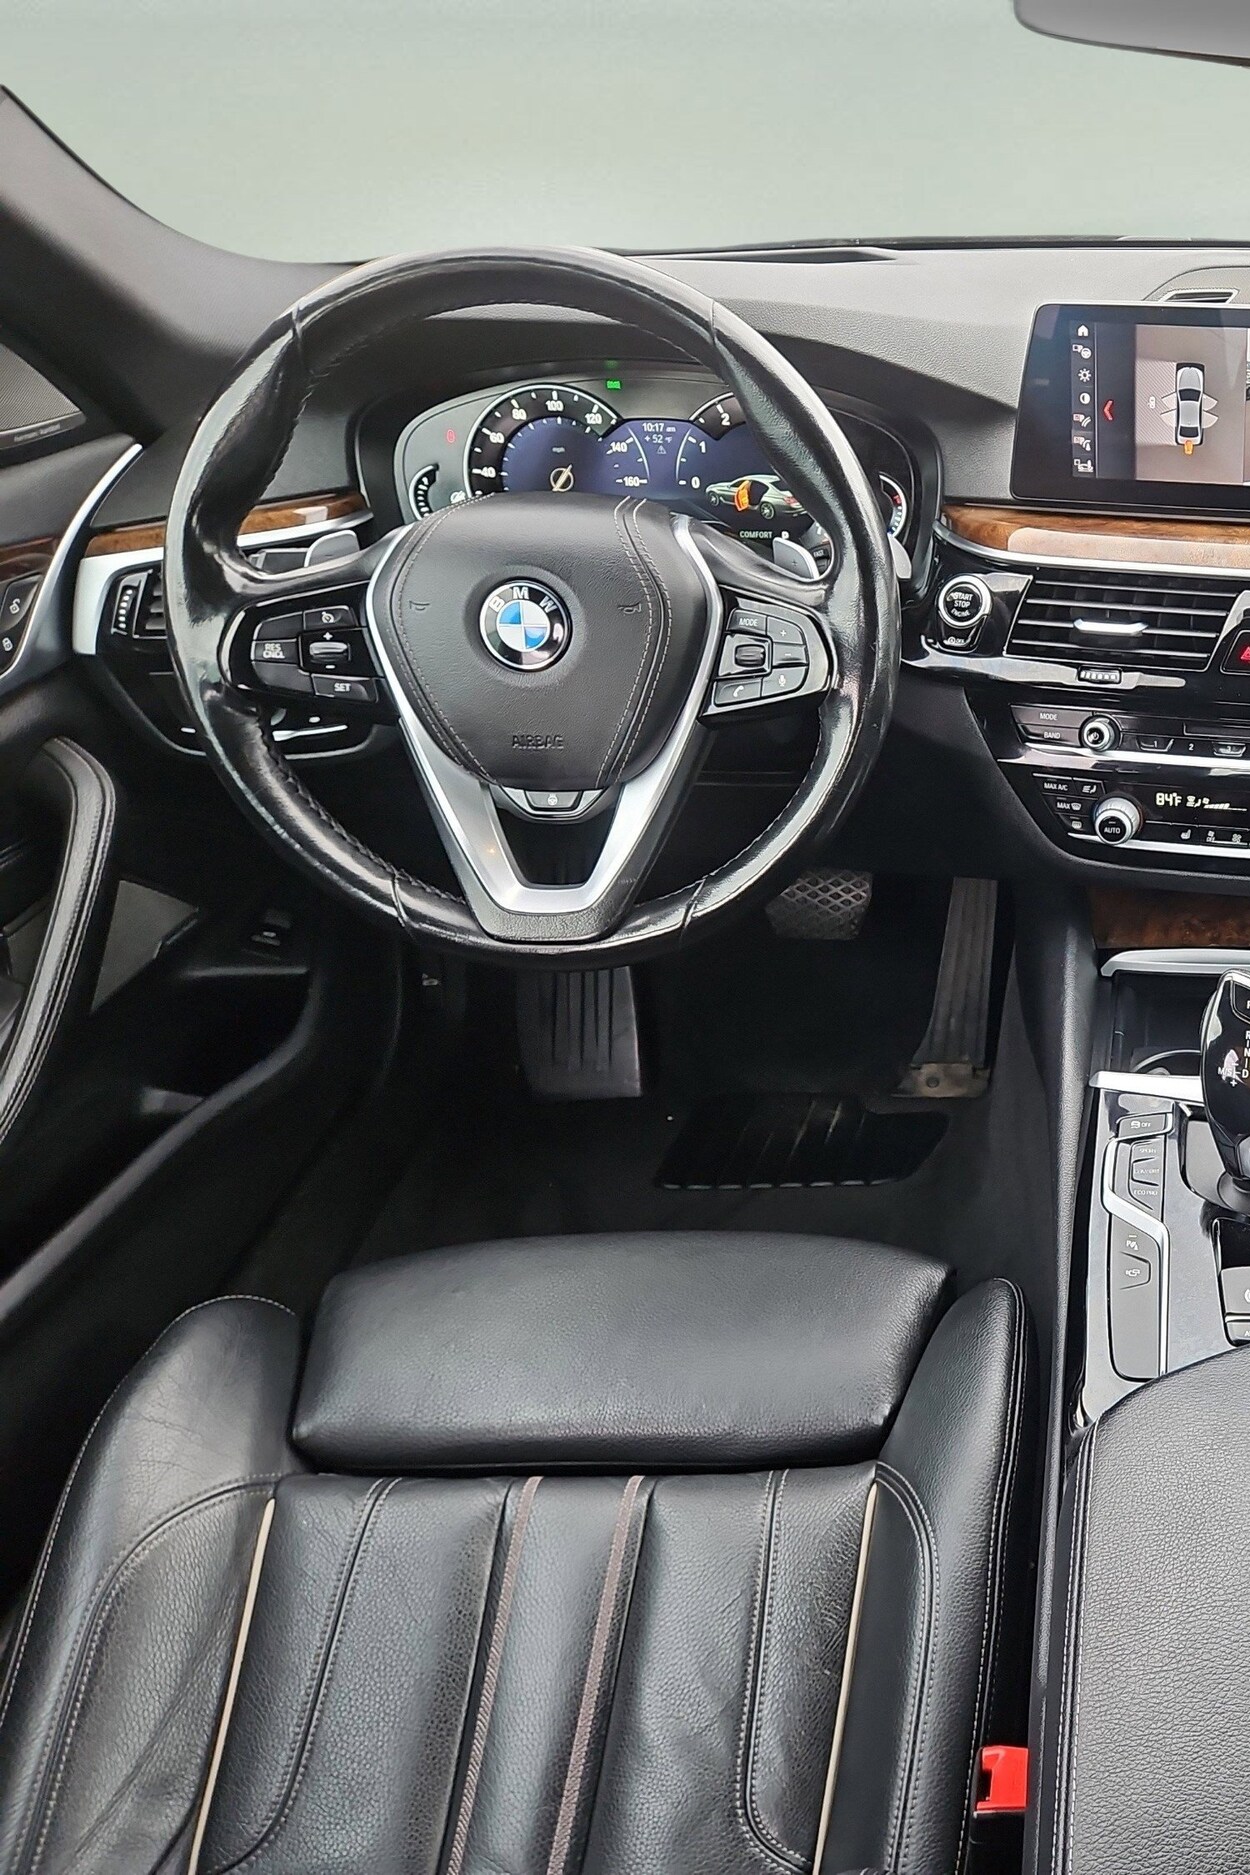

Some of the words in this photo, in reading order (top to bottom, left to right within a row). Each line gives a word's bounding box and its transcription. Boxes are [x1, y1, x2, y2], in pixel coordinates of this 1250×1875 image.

[545, 400, 564, 412] 100
[511, 408, 527, 421] 80
[584, 411, 603, 425] 120
[720, 412, 731, 426] 2
[642, 423, 665, 432] 10:17
[489, 431, 505, 444] 60
[652, 434, 664, 443] 52
[609, 441, 628, 453] 140
[699, 441, 707, 454] 1
[480, 466, 497, 479] 40
[622, 476, 640, 487] 160
[691, 476, 701, 489] 0
[739, 530, 773, 540] COMFORT
[488, 586, 558, 614] BMW
[953, 591, 974, 601] START
[954, 600, 971, 608] STOP
[738, 617, 758, 627] MODE
[264, 643, 282, 652] RES
[333, 682, 352, 692] SET
[1039, 712, 1058, 721] MODE
[1043, 731, 1061, 740] BAND
[511, 734, 565, 750] AIRBAG
[1153, 740, 1158, 748] 1
[1188, 743, 1194, 751] 2
[1226, 744, 1232, 752] 3
[1044, 782, 1058, 790] MAX
[1058, 783, 1069, 791] A/C
[1056, 801, 1071, 810] MAX
[1103, 826, 1121, 835] AUTO
[1241, 1069, 1250, 1079] D
